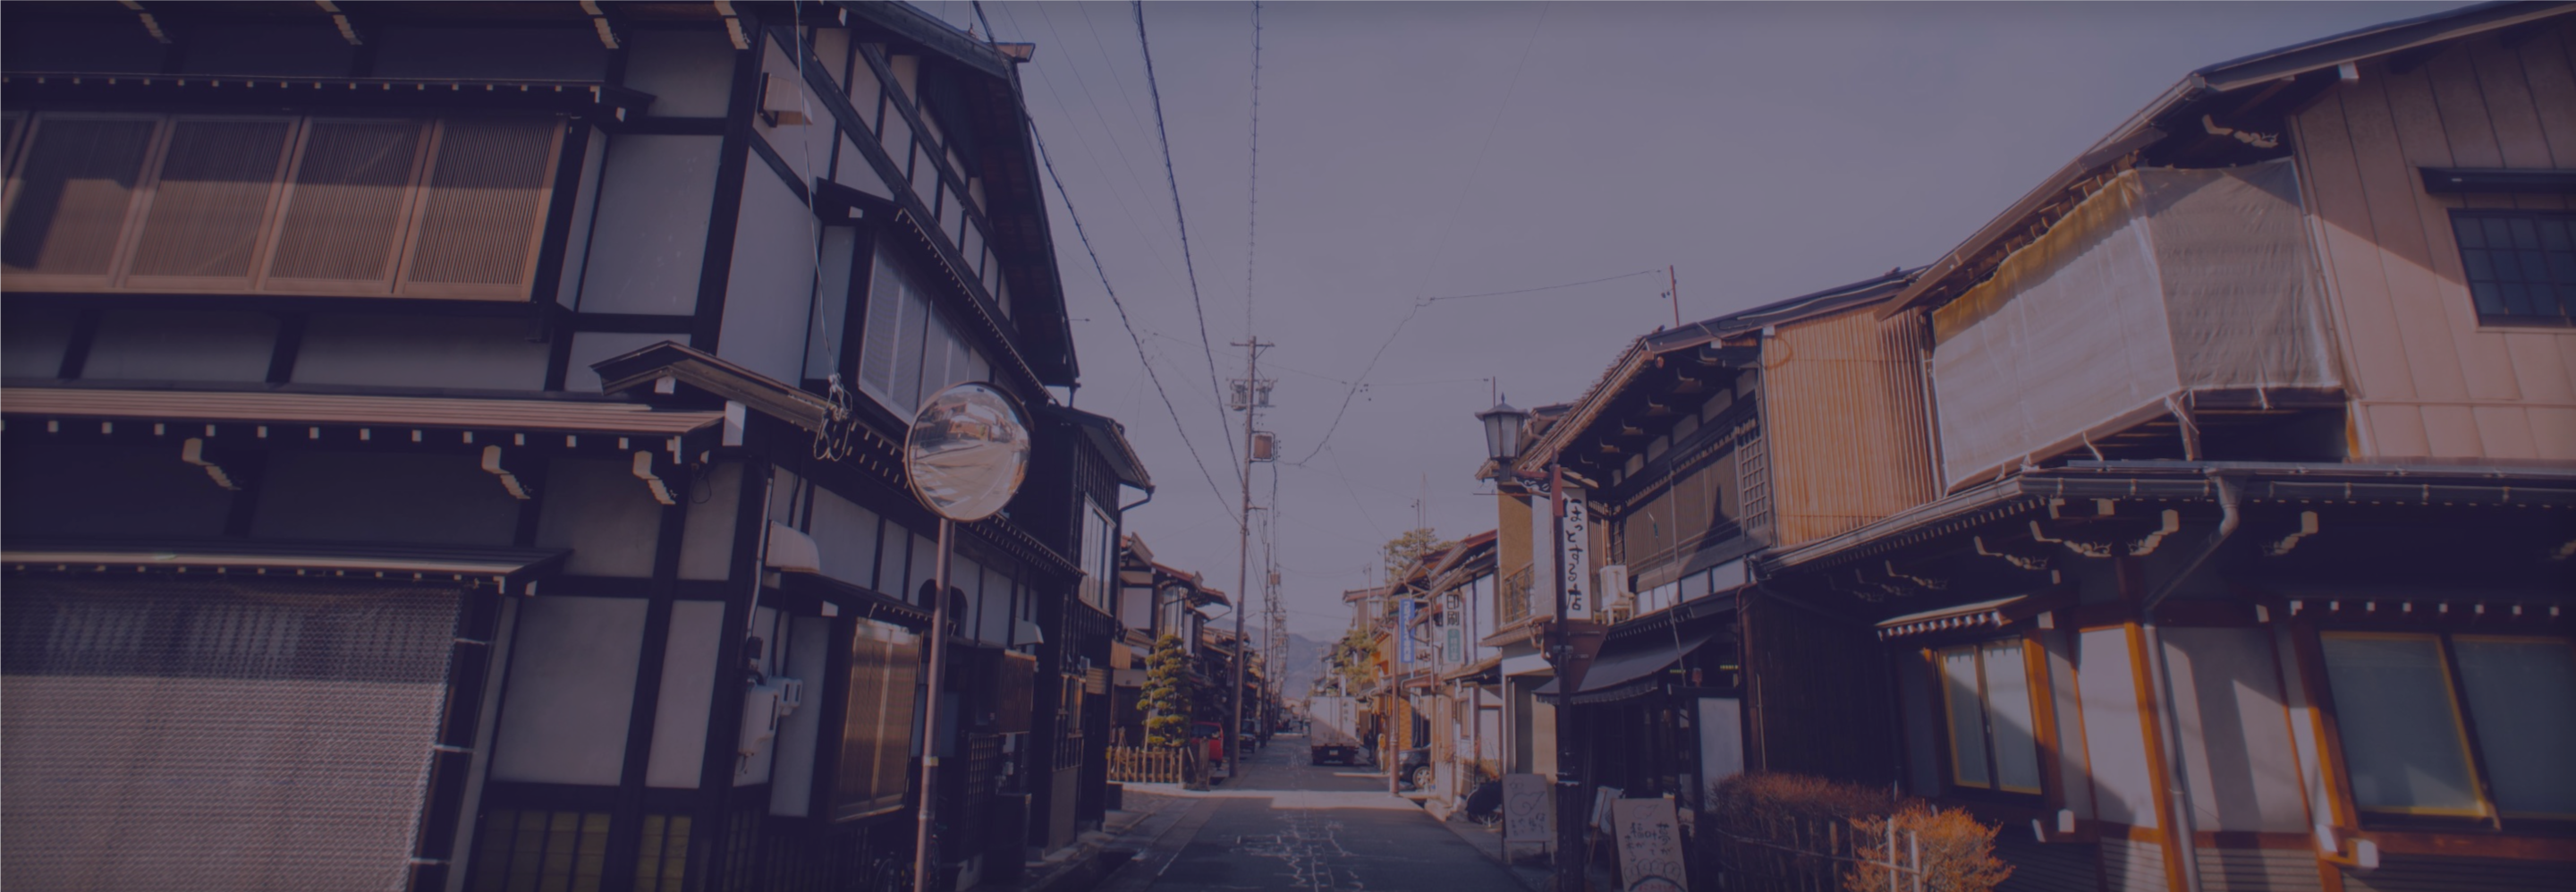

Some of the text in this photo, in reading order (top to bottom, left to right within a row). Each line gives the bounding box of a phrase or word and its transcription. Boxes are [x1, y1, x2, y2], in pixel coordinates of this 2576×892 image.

[1563, 497, 1583, 611] ほっとする店
[1446, 593, 1460, 626] 印刷
